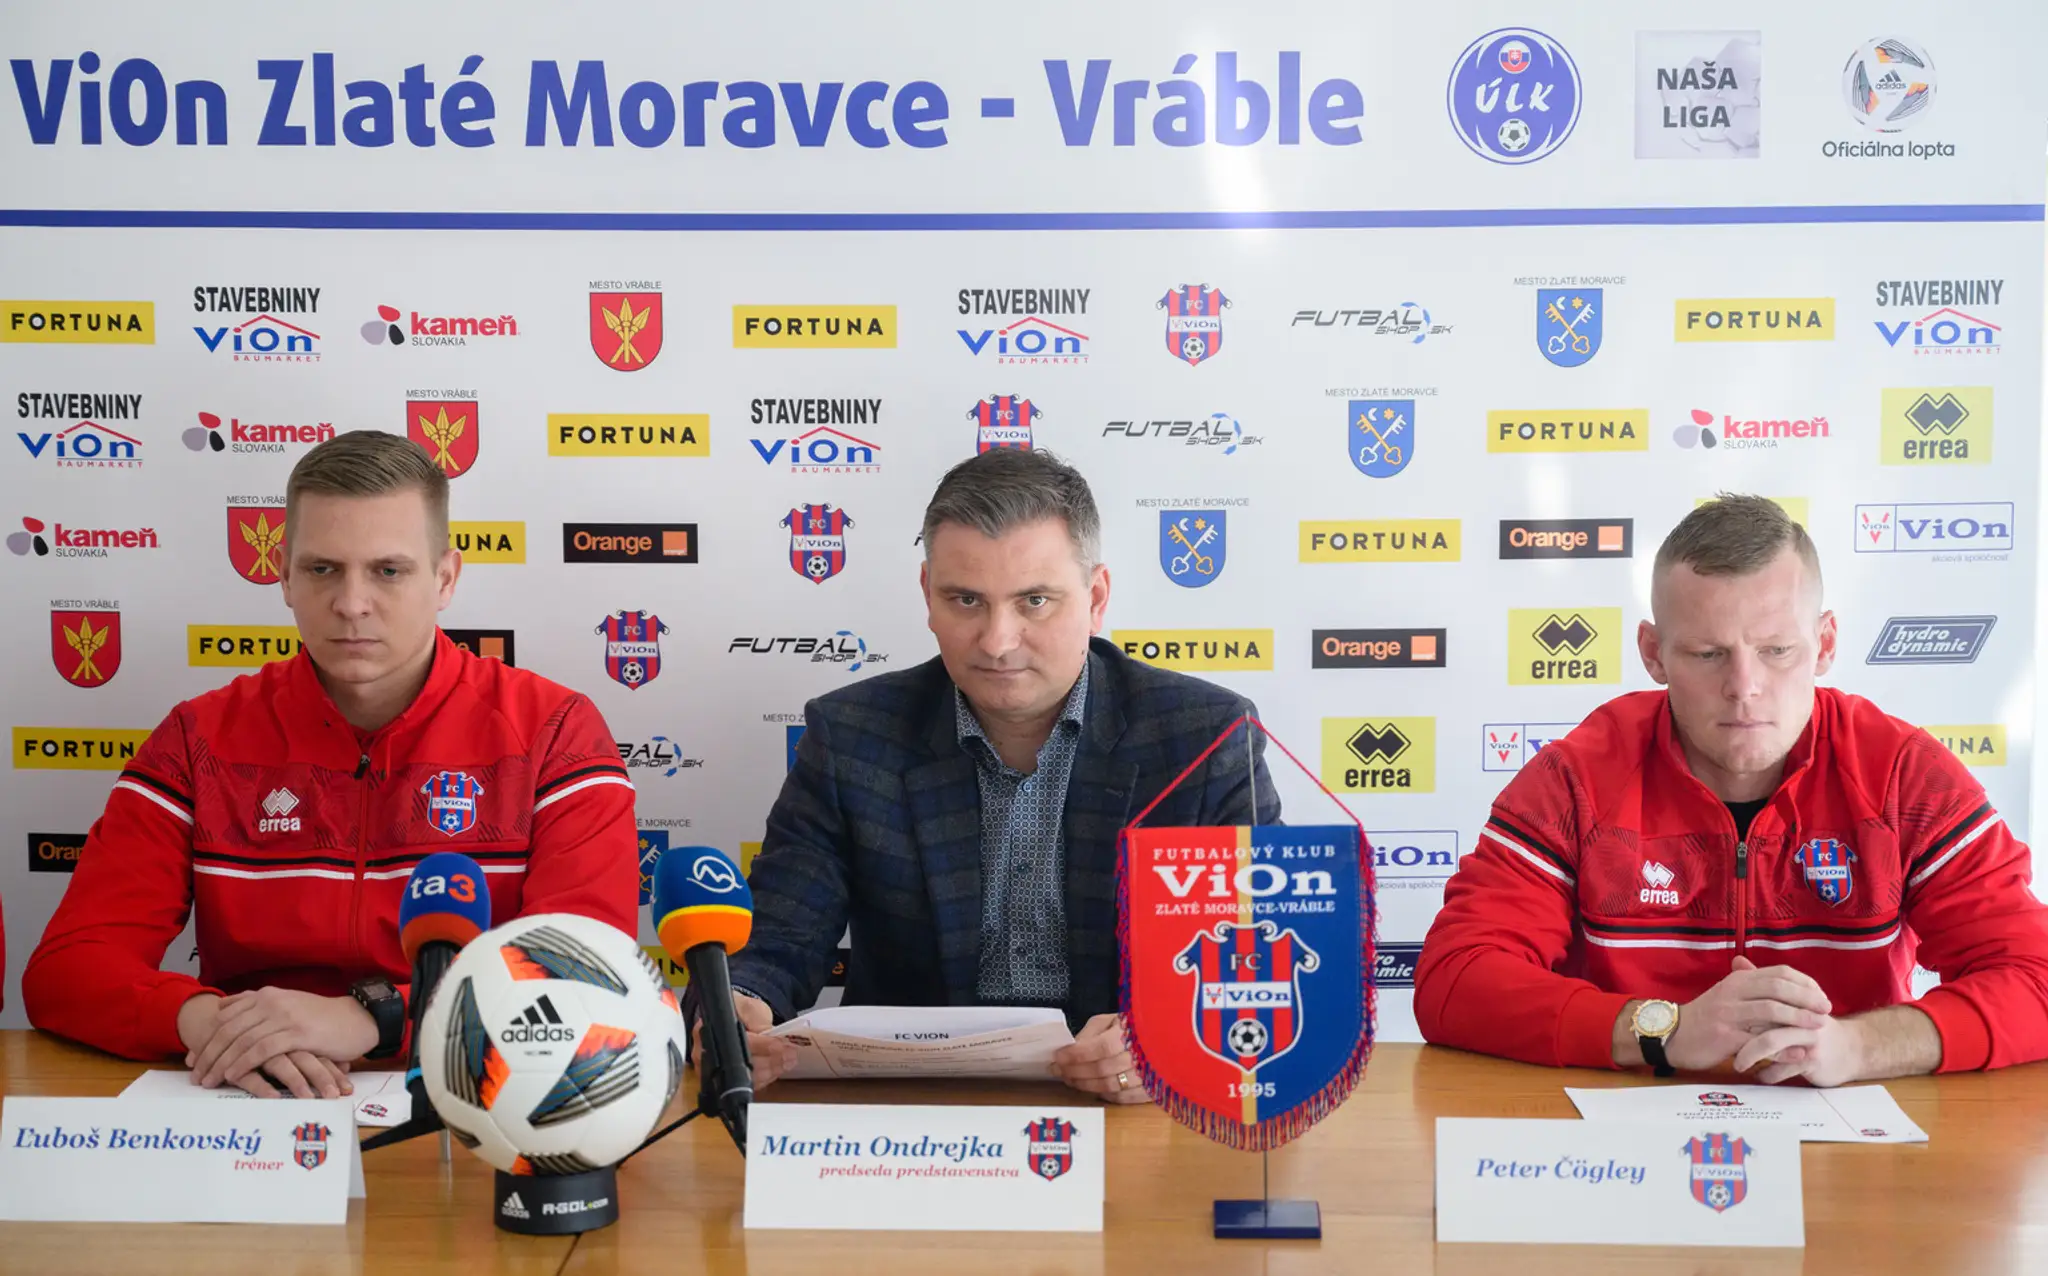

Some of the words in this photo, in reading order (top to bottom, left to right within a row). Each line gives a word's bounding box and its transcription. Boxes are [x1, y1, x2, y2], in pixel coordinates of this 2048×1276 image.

[1656, 61, 1738, 91] NAŠA
[10, 51, 228, 145] ViOn
[257, 52, 496, 148] Zlaté
[525, 60, 949, 149] Moravce
[981, 97, 1015, 118] -
[1043, 50, 1364, 147] Vráble
[1475, 78, 1554, 113] ÚLK
[1662, 106, 1731, 128] LIGA
[1822, 140, 1904, 157] Oficiálna
[1908, 140, 1955, 160] lopta
[589, 281, 622, 289] MESTO
[1514, 277, 1547, 285] MESTO
[1580, 276, 1626, 285] MORAVCE
[194, 286, 321, 313] STAVEBNINY
[958, 289, 1090, 315] STAVEBNINY
[1876, 280, 2004, 307] STAVEBNINY
[1186, 299, 1204, 311] FC
[11, 312, 143, 332] FORTUNA
[410, 311, 516, 336] kameň
[745, 317, 884, 336] FORTUNA
[1184, 319, 1218, 328] ViOn
[1291, 309, 1423, 327] FUTBAL
[1687, 311, 1822, 329] FORTUNA
[192, 327, 313, 353] ViOn
[411, 336, 466, 347] SLOVAKIA
[957, 329, 1080, 356] ViOn
[1874, 321, 1995, 347] ViOn
[406, 389, 439, 398] MESTO
[1325, 388, 1358, 397] MESTO
[1391, 387, 1438, 397] MORAVCE
[18, 393, 142, 419] STAVEBNINY
[751, 399, 882, 424] STAVEBNINY
[996, 409, 1014, 421] FC
[232, 418, 335, 443] kameň
[560, 426, 697, 444] FORTUNA
[995, 429, 1028, 439] ViOn
[1102, 421, 1233, 438] FUTBAL
[1499, 421, 1636, 440] FORTUNA
[1724, 415, 1830, 439] kameň
[17, 433, 134, 458] ViOn
[232, 443, 286, 453] SLOVAKIA
[750, 438, 872, 465] ViOn
[1724, 439, 1778, 450] SLOVAKIA
[227, 495, 259, 504] MESTO
[261, 495, 286, 504] VRÁB
[1136, 498, 1169, 507] MESTO
[1203, 497, 1249, 507] MORAVCE
[808, 518, 826, 529] FC
[1899, 518, 2010, 539] ViOn
[55, 523, 156, 548] kameň
[573, 531, 652, 555] Orange
[806, 538, 841, 548] ViOn
[1312, 532, 1448, 550] FORTUNA
[1509, 528, 1588, 550] Orange
[55, 547, 108, 558] SLOVAKIA
[51, 600, 83, 608] MESTO
[624, 625, 641, 635] FC
[1895, 625, 1950, 641] hydro
[200, 637, 303, 655] FORTU
[623, 645, 656, 654] ViOn
[728, 637, 858, 654] FUTBAL
[1125, 642, 1260, 660] FORTUNA
[1322, 637, 1400, 660] Orange
[1888, 638, 1968, 657] dynamic
[763, 714, 796, 722] MESTO
[24, 739, 134, 758] FORTUN
[445, 785, 459, 793] FC
[645, 819, 691, 828] MORAVCE
[1153, 844, 1274, 861] FUTBALOVÝ
[1282, 845, 1336, 859] KLUB
[1375, 846, 1454, 866] iOn
[1818, 852, 1832, 861] FC
[410, 874, 476, 902] ta3
[1153, 863, 1337, 897] ViOn
[1155, 899, 1200, 915] ZLATÉ
[1204, 900, 1335, 914] MORAVCE-VRÁBLE
[1230, 953, 1262, 971] FC
[1228, 990, 1289, 1002] ViOn
[501, 1024, 575, 1043] adidas
[913, 1032, 949, 1040] VION
[1228, 1083, 1276, 1097] 1995
[15, 1127, 100, 1149] Ľuboš
[108, 1128, 262, 1156] Benkovský
[762, 1134, 854, 1157] Martin
[870, 1135, 1003, 1162] Ondrejka
[234, 1158, 285, 1170] tréner
[819, 1164, 892, 1179] predseda
[896, 1164, 1019, 1179] predstavenstva
[1476, 1158, 1548, 1178] Peter
[1553, 1156, 1646, 1185] Čögley
